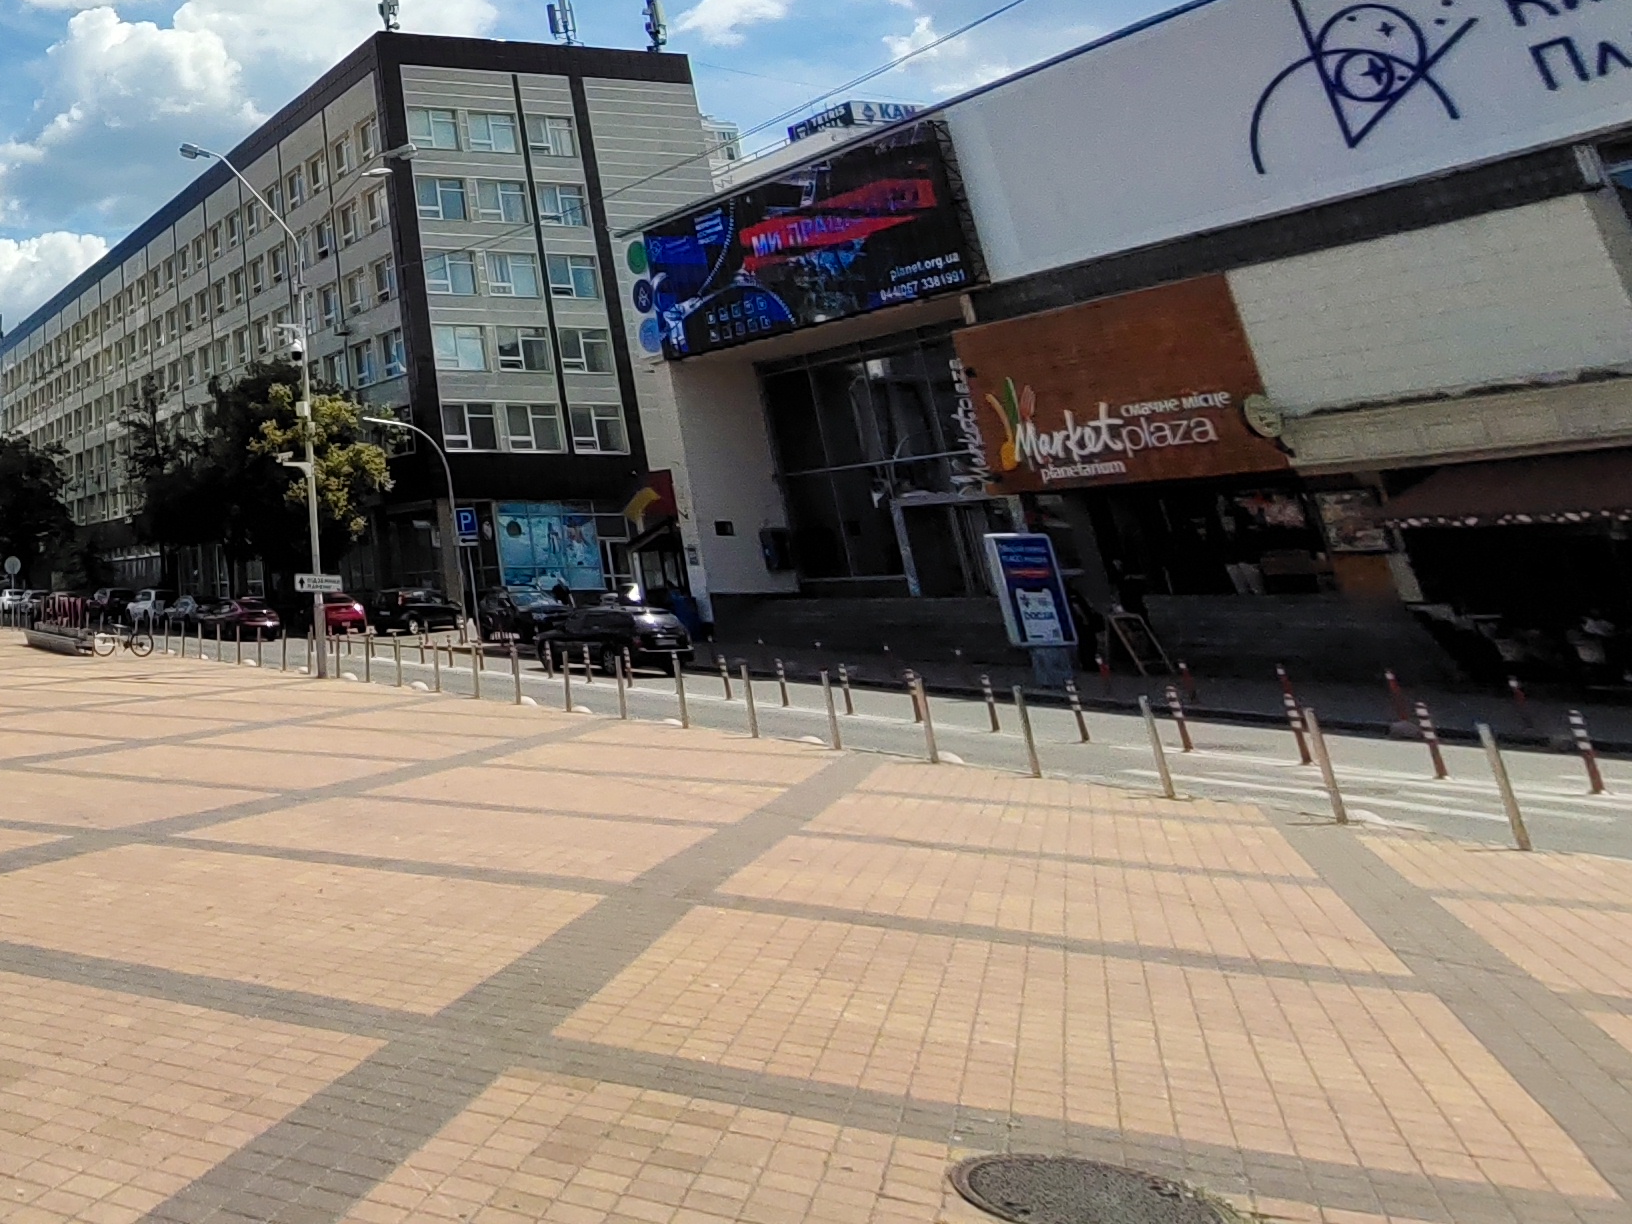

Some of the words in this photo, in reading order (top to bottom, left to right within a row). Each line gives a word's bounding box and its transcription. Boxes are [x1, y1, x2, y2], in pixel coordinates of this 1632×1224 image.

[751, 231, 783, 257] МИ
[889, 251, 961, 281] planet.org.ua
[1120, 395, 1179, 417] смачне
[1181, 390, 1232, 410] місце
[1040, 459, 1126, 484] planetarium
[460, 512, 472, 531] P
